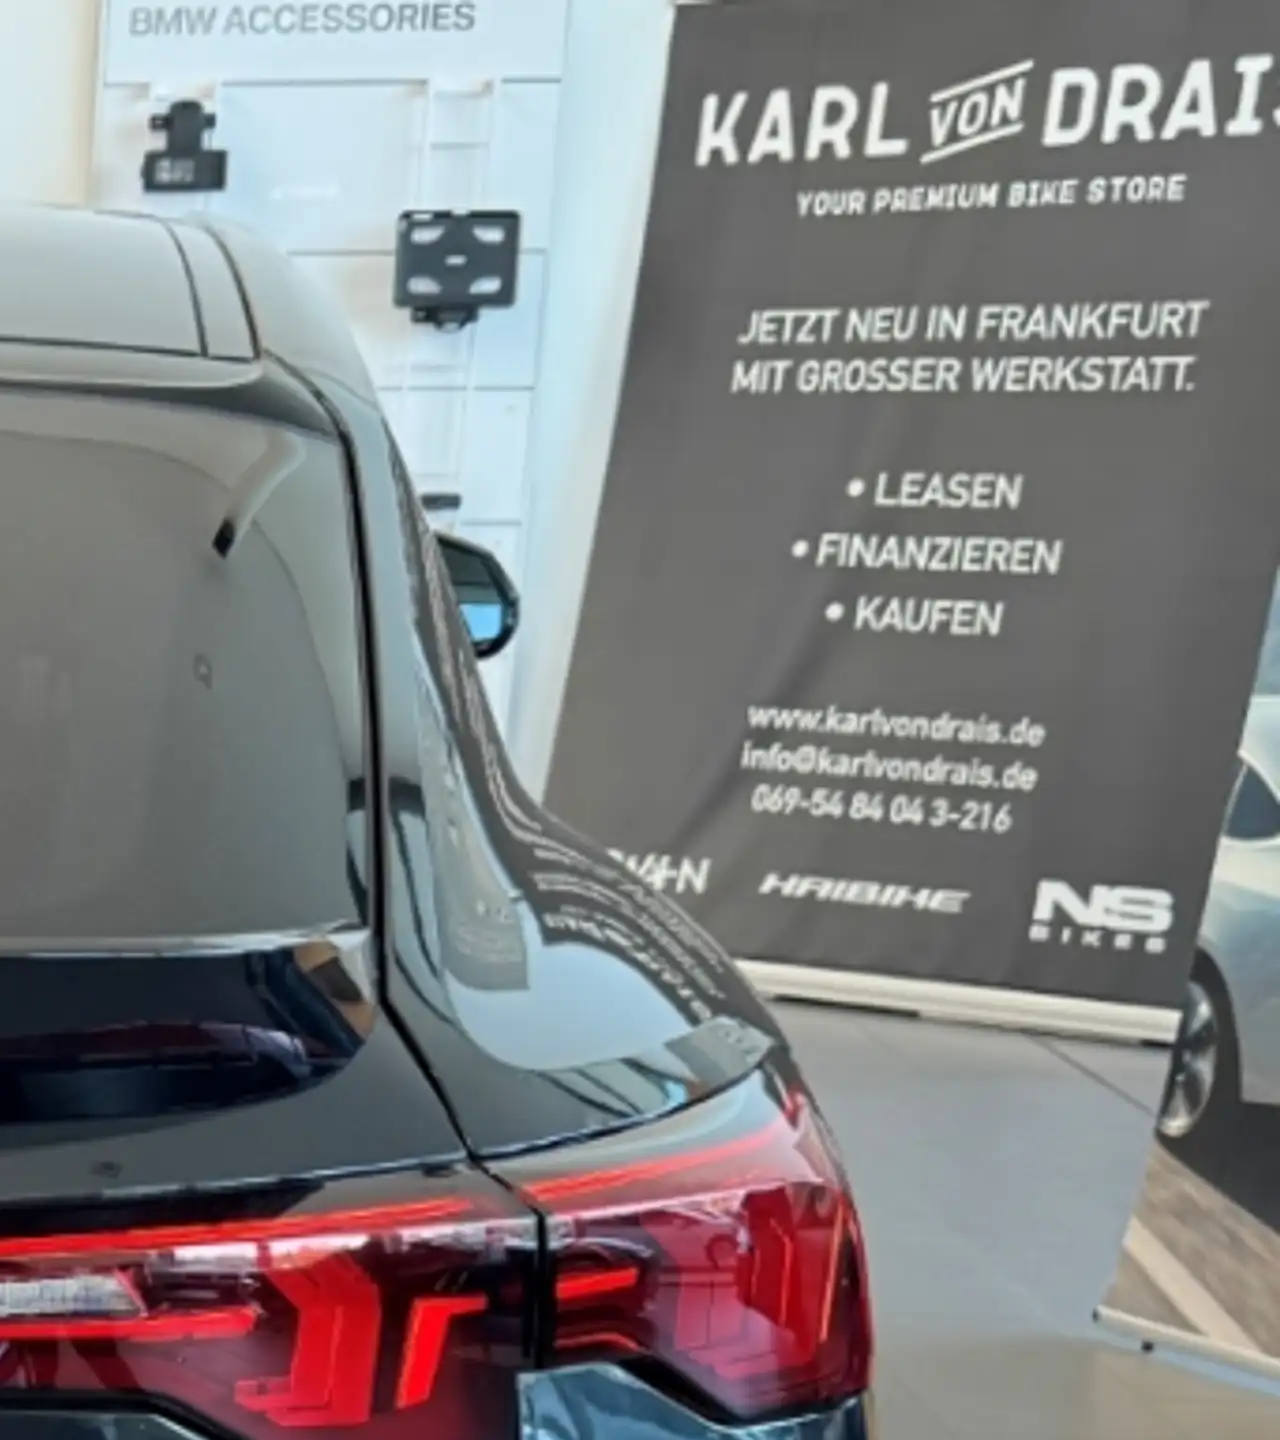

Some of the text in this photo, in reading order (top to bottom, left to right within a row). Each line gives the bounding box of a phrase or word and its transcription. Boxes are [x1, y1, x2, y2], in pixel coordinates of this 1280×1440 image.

[128, 2, 477, 38] BMW ACCESSORIES
[694, 52, 1280, 168] KARL VON DRAI
[796, 172, 1188, 217] YOUR PREMIUM BIKE STORE
[736, 299, 1210, 345] JETZT NEU IN FRANKFURT
[730, 354, 1198, 395] MIT GROSSER WERKSTATT.
[873, 471, 1025, 510] LEASEN
[814, 531, 1064, 575] FINANZIEREN
[853, 595, 1005, 638] KAUFEN
[746, 703, 1047, 748] www.karlvondrais.de
[740, 740, 1040, 791] info@karlvondrais.de
[848, 790, 885, 823] 84
[927, 796, 1014, 836] 3-216
[757, 872, 1176, 935] HAIBIKE NS
